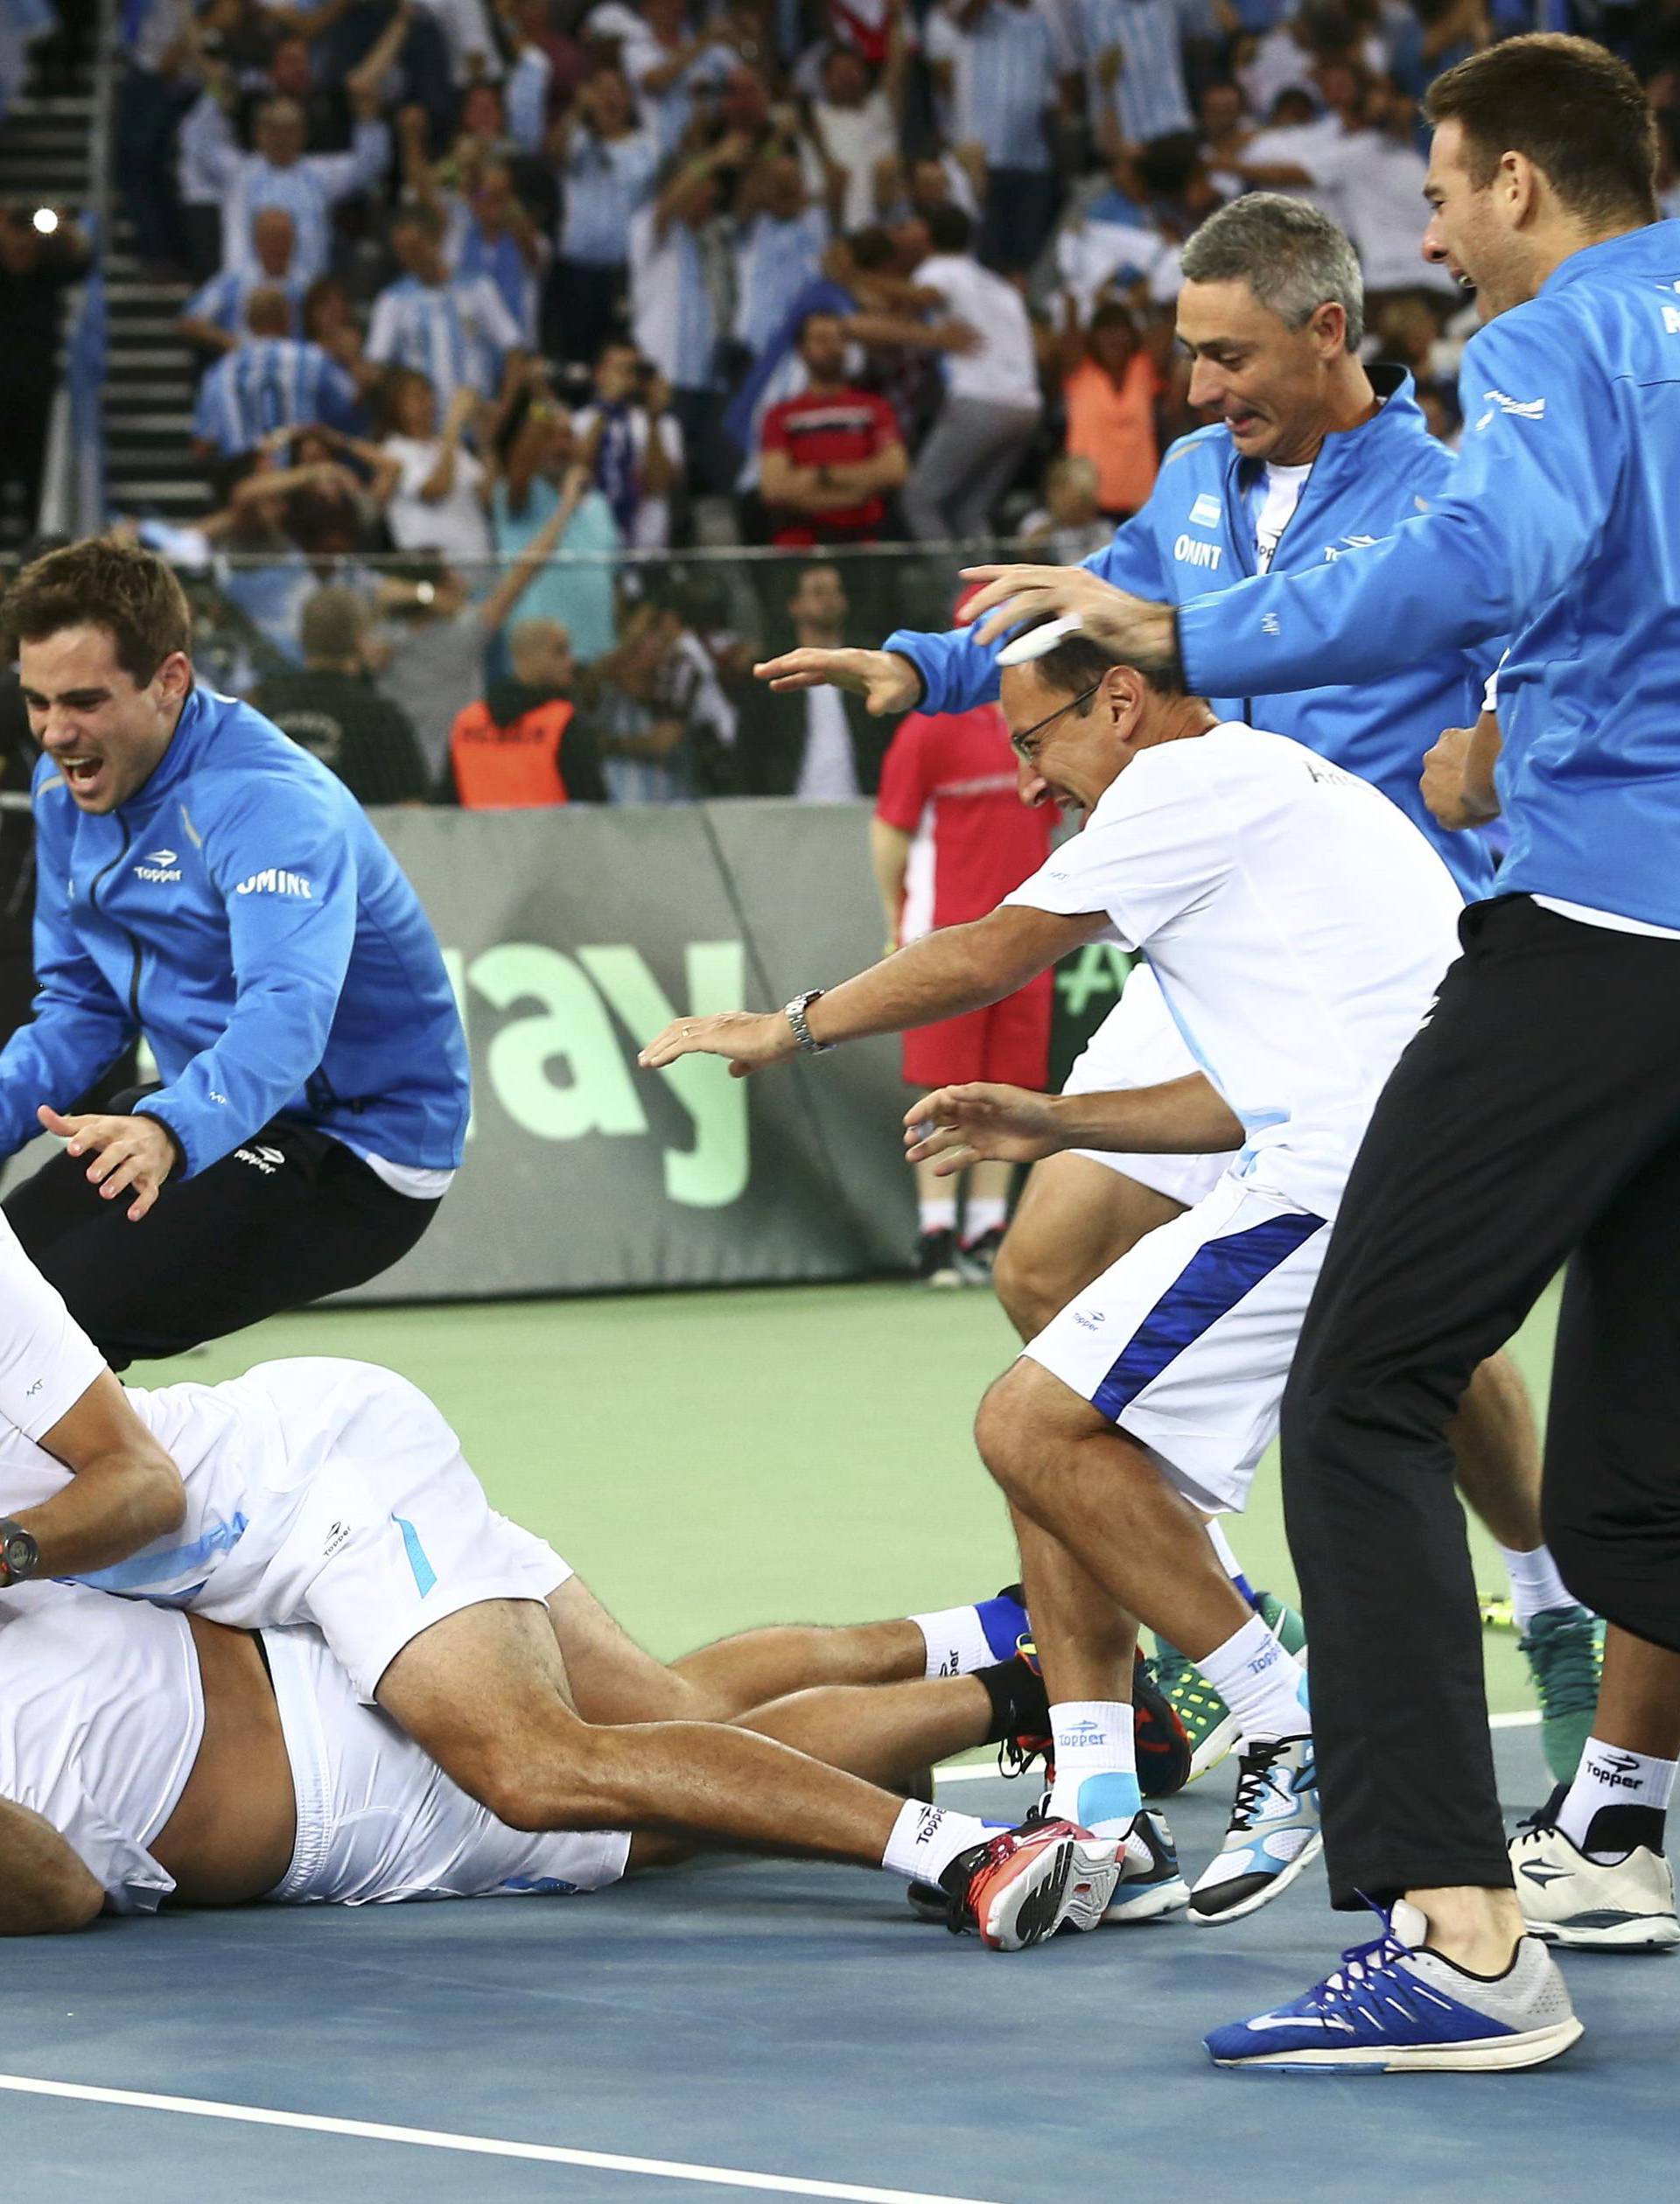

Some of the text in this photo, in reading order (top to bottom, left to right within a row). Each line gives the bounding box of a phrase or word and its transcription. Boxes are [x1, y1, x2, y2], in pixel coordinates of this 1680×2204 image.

[134, 866, 182, 883] Topper
[234, 1148, 277, 1175] Topper
[1074, 1312, 1099, 1332] Topper
[323, 1526, 352, 1557] Topper
[1058, 1733, 1107, 1747] Topper
[1586, 1760, 1644, 1790] Topper
[915, 1808, 947, 1845] Toppe
